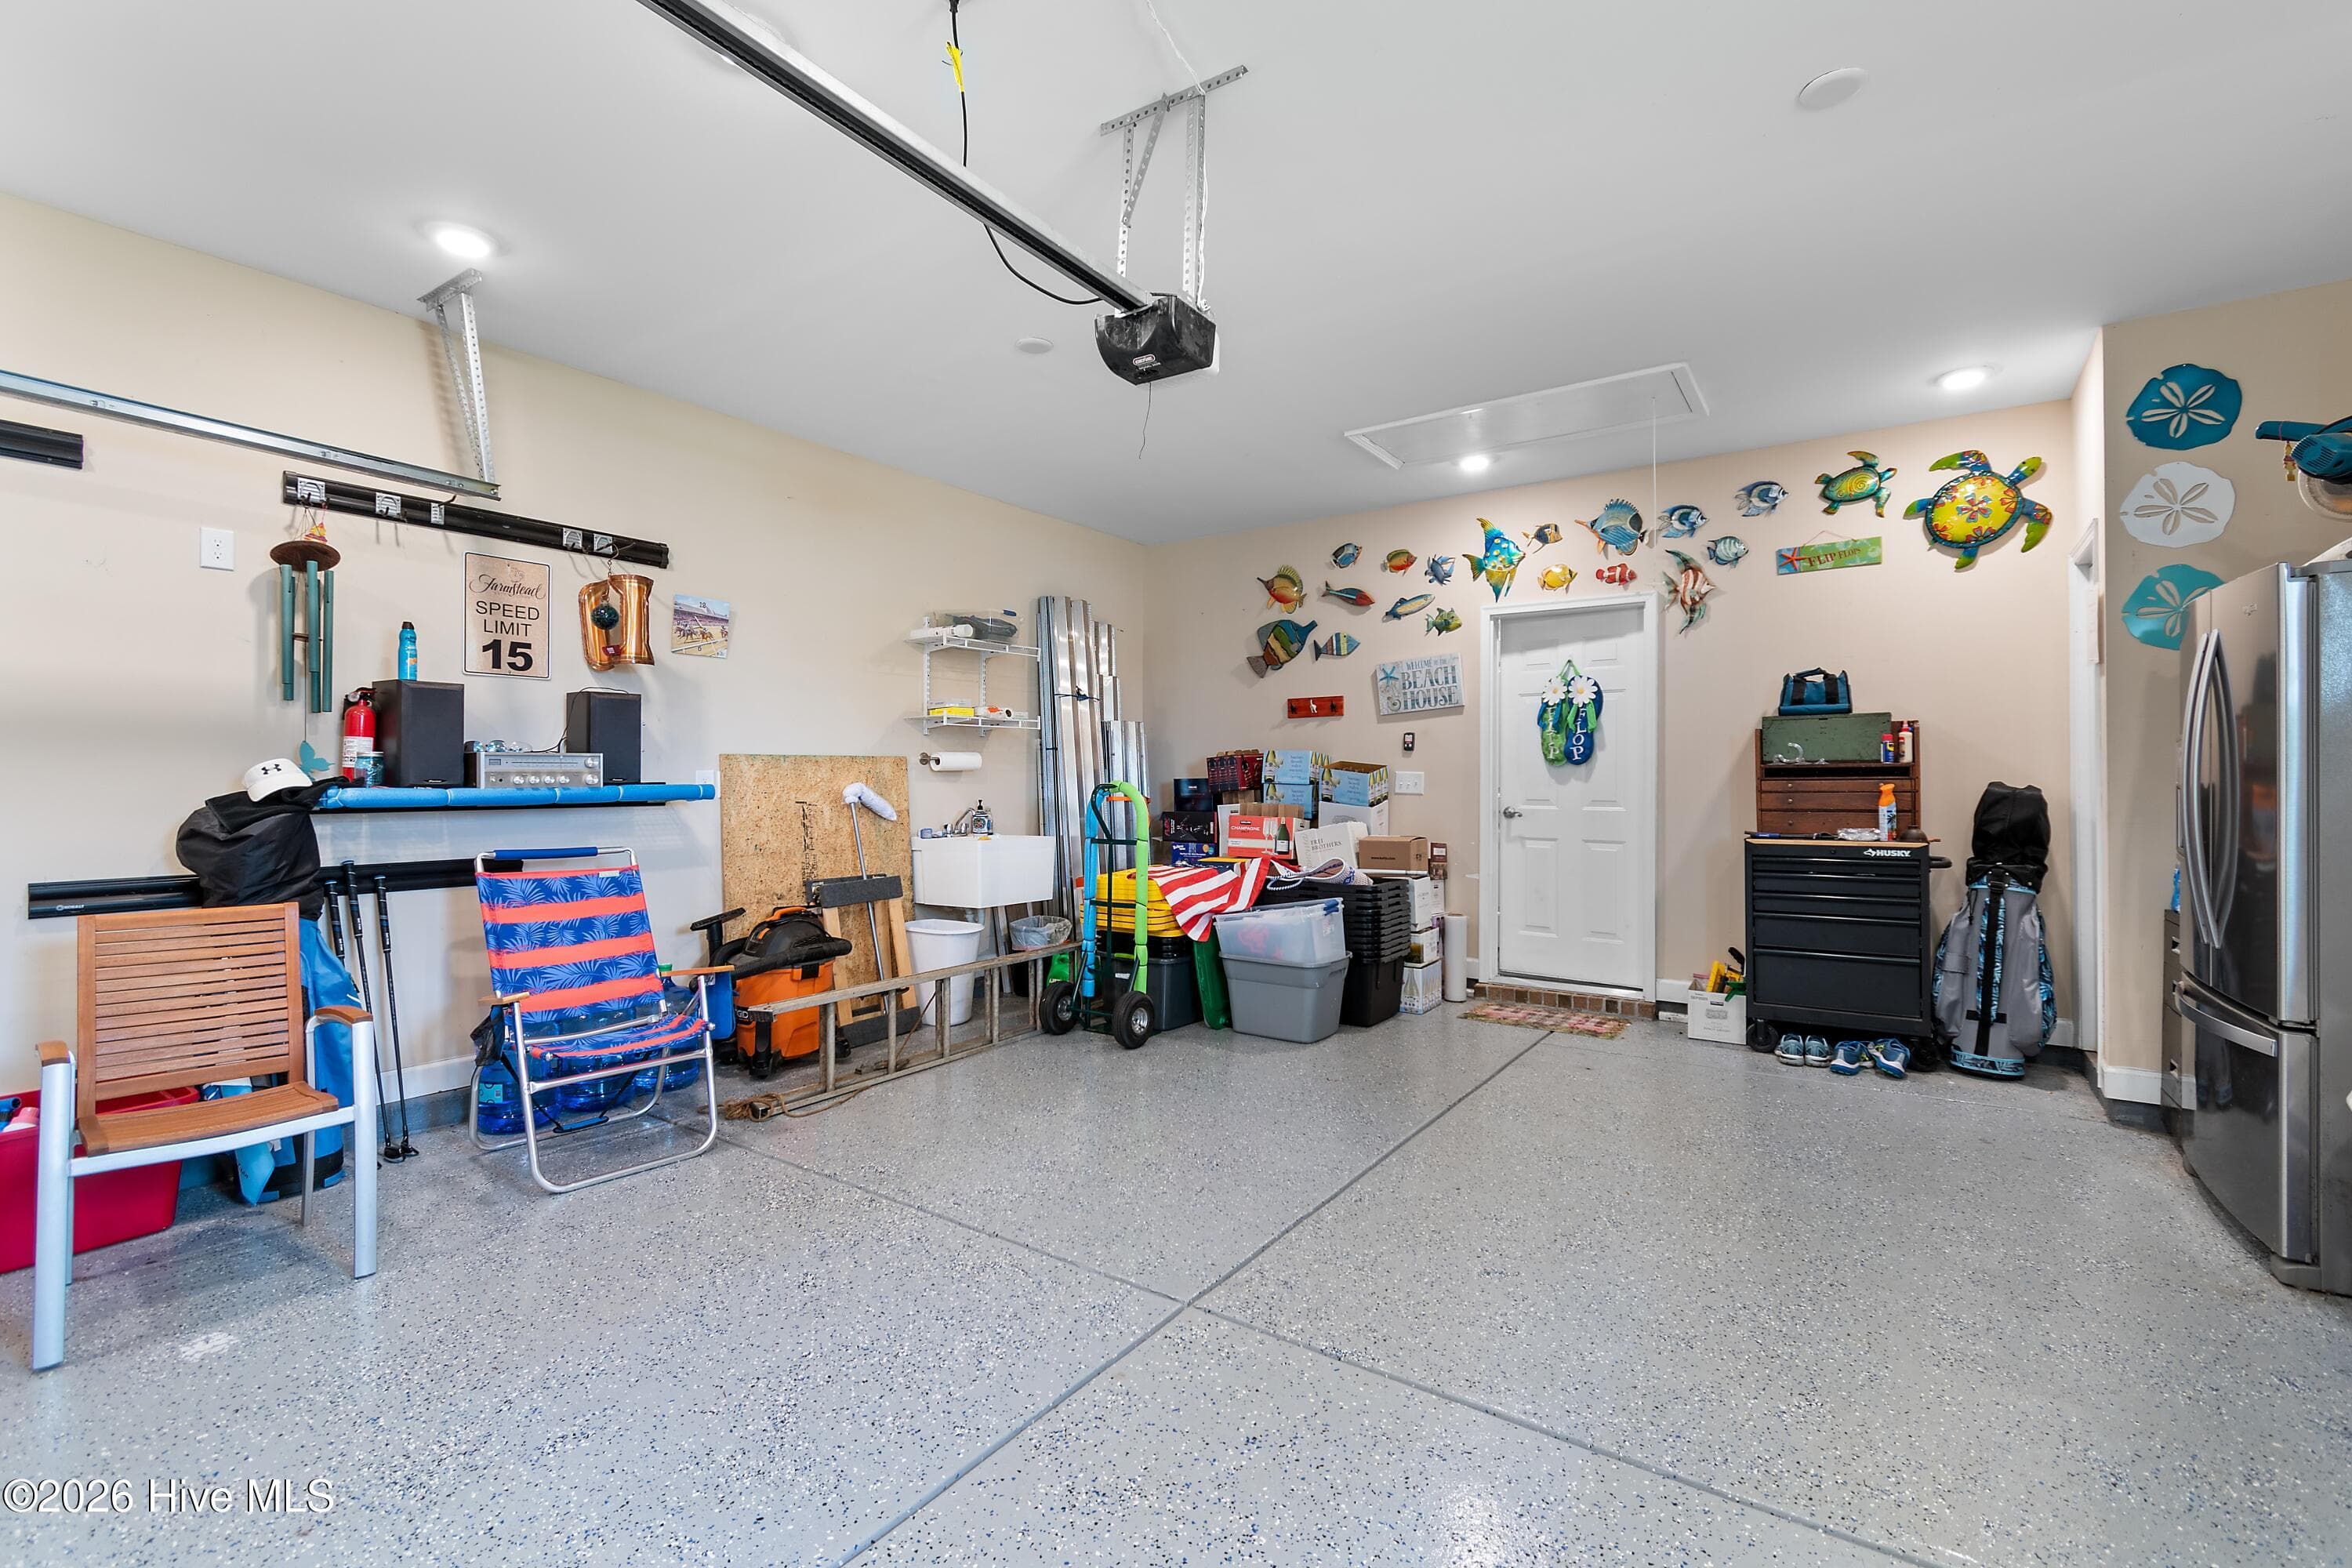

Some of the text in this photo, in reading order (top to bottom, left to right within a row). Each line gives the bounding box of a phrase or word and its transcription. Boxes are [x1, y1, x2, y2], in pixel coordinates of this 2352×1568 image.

[1807, 552, 1836, 567] FLIP
[470, 574, 546, 600] Farmstead
[476, 601, 539, 621] SPEED
[484, 619, 532, 637] LIMIT
[482, 639, 533, 672] 15
[1400, 665, 1457, 690] BEACH
[1403, 685, 1459, 710] HOUSE
[1570, 708, 1587, 760] FLOP
[1312, 840, 1342, 851] BROTHERS
